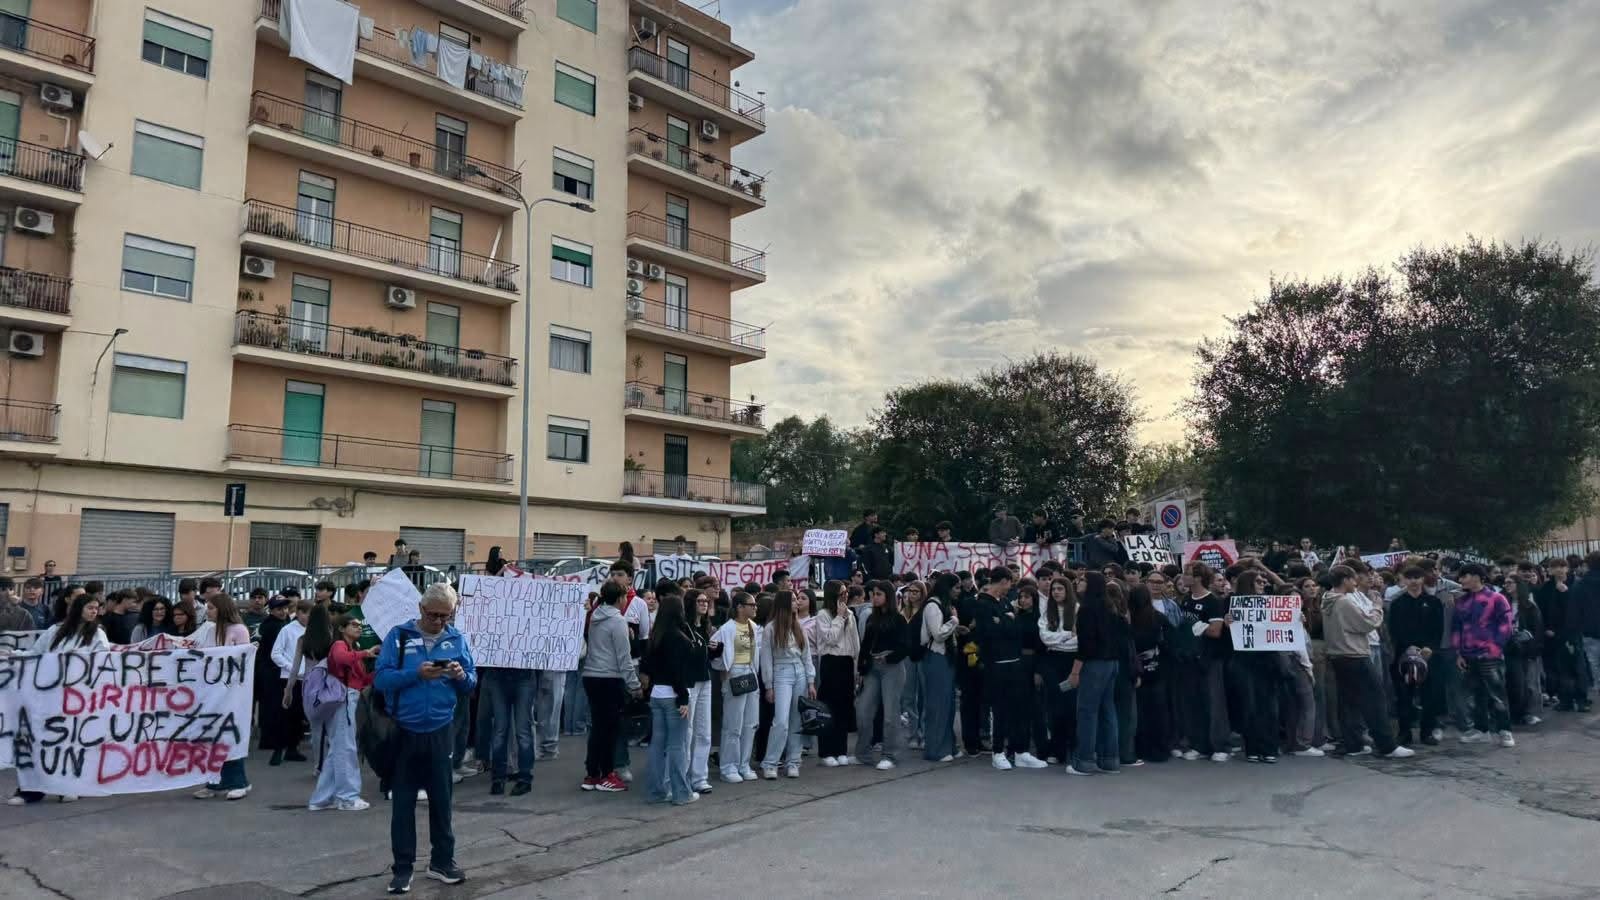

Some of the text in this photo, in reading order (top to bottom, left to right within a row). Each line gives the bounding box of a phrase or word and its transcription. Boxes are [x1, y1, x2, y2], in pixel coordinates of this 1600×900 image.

[900, 542, 949, 560] UNA
[1126, 535, 1147, 550] LA
[708, 560, 790, 586] NEGATE
[461, 577, 482, 598] LA
[482, 577, 533, 601] SCUOLA
[504, 598, 522, 617] LE
[523, 600, 559, 620] PORTE
[1256, 609, 1266, 622] UN
[1270, 610, 1292, 622] LUSSO
[515, 617, 531, 637] LA
[1242, 623, 1254, 636] MA
[1243, 636, 1254, 649] UN
[470, 648, 498, 666] OSTRE
[0, 652, 171, 691] STUDIARE
[203, 652, 247, 685] UN
[0, 703, 241, 747] LA SICUREZZA
[40, 746, 86, 778] UN
[97, 741, 231, 785] DOVERE
